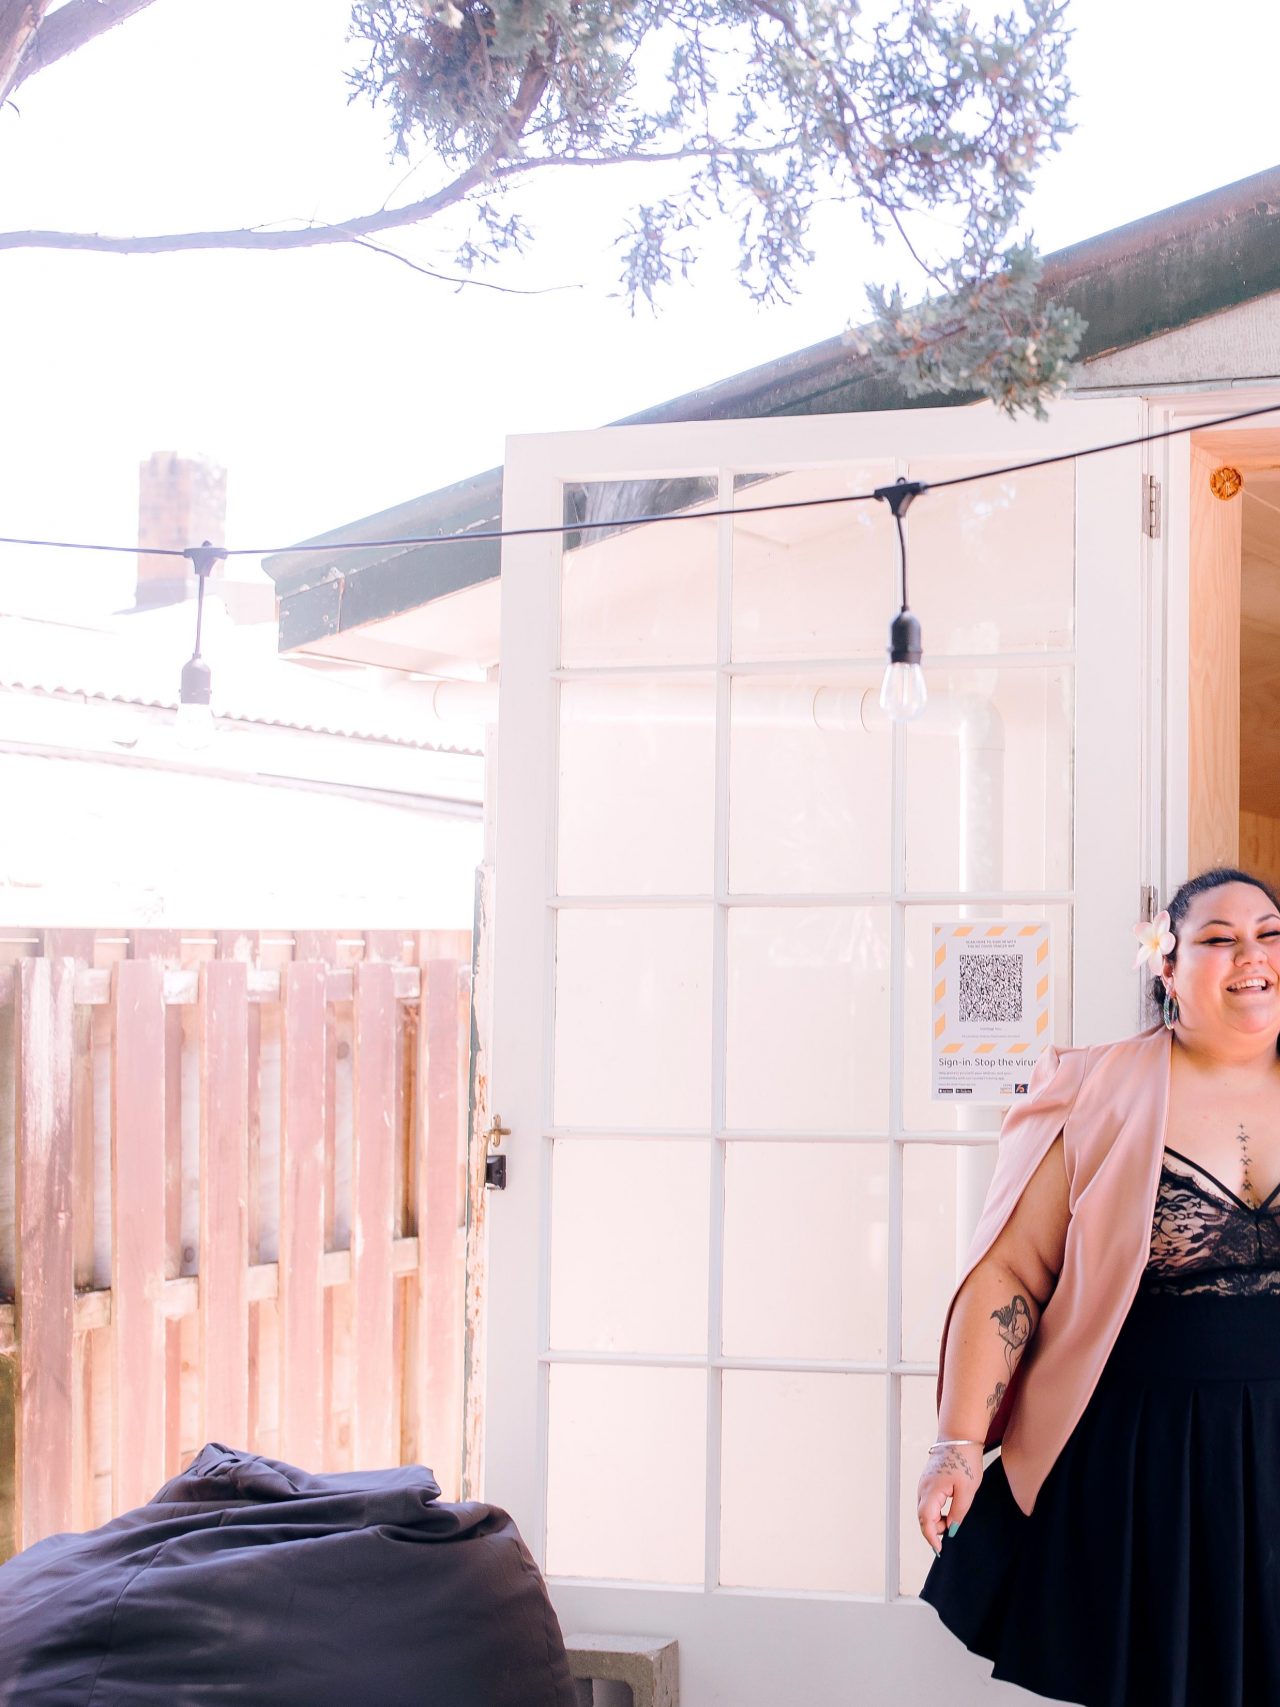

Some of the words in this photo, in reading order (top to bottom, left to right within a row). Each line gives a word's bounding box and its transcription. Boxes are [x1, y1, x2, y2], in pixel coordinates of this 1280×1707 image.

[938, 1057, 973, 1068] Sign-in.
[974, 1057, 996, 1068] Stop
[997, 1057, 1014, 1067] the
